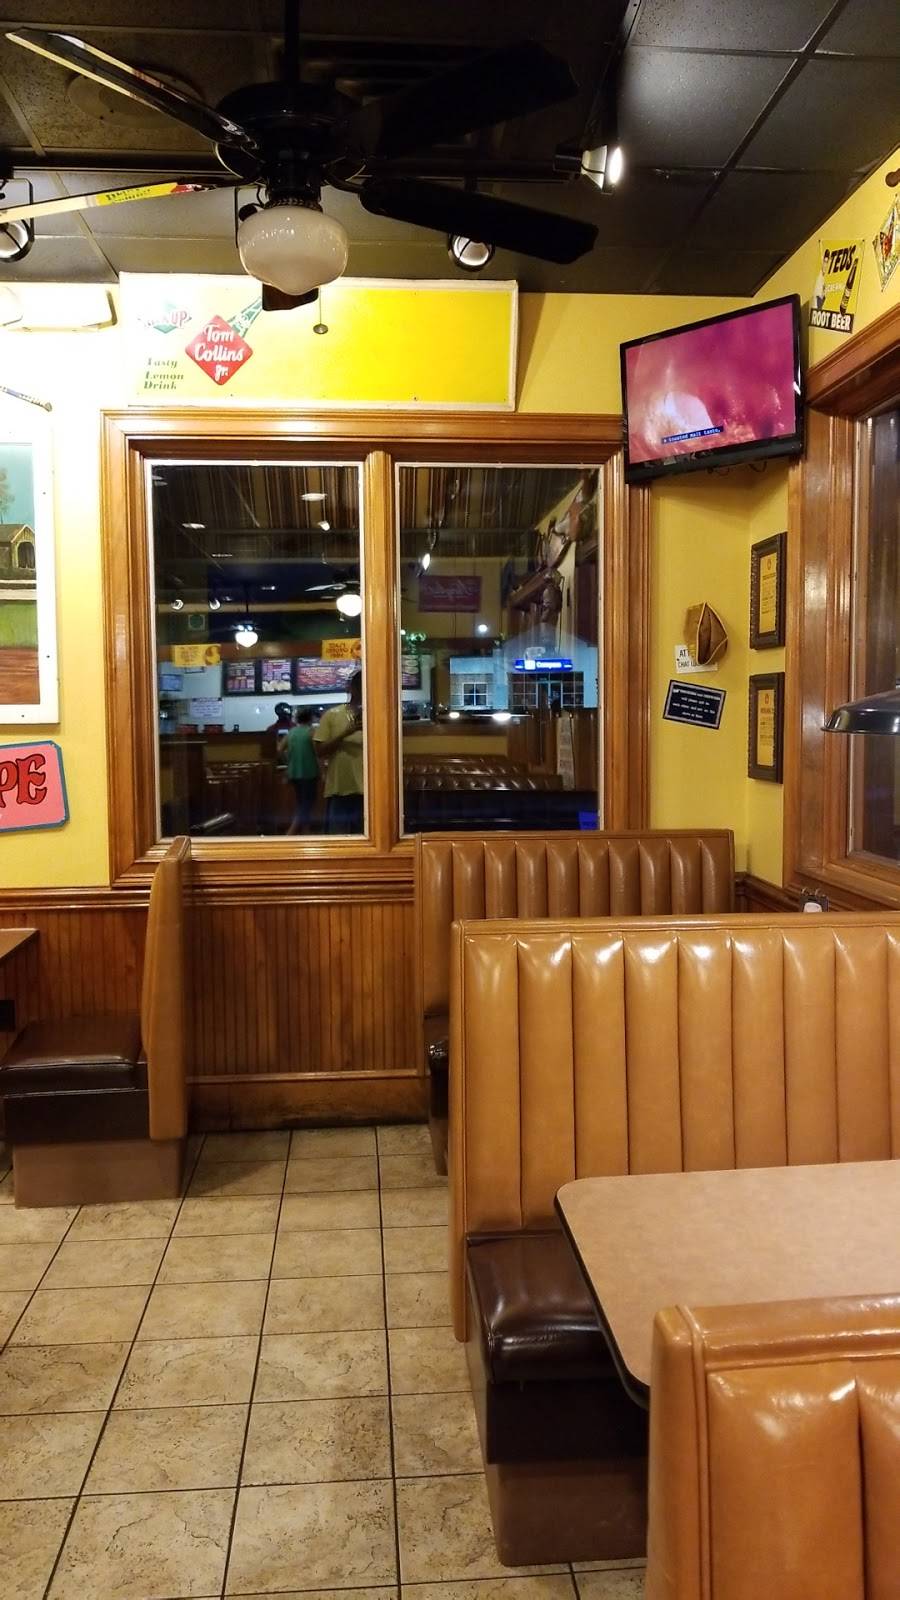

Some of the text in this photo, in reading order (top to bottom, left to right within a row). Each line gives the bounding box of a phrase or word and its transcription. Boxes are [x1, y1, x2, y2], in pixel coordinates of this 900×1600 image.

[811, 310, 851, 330] ROOT BEER
[203, 323, 234, 342] Tom
[194, 343, 244, 361] Collins
[144, 370, 184, 380] Lemon
[143, 381, 177, 390] Drink
